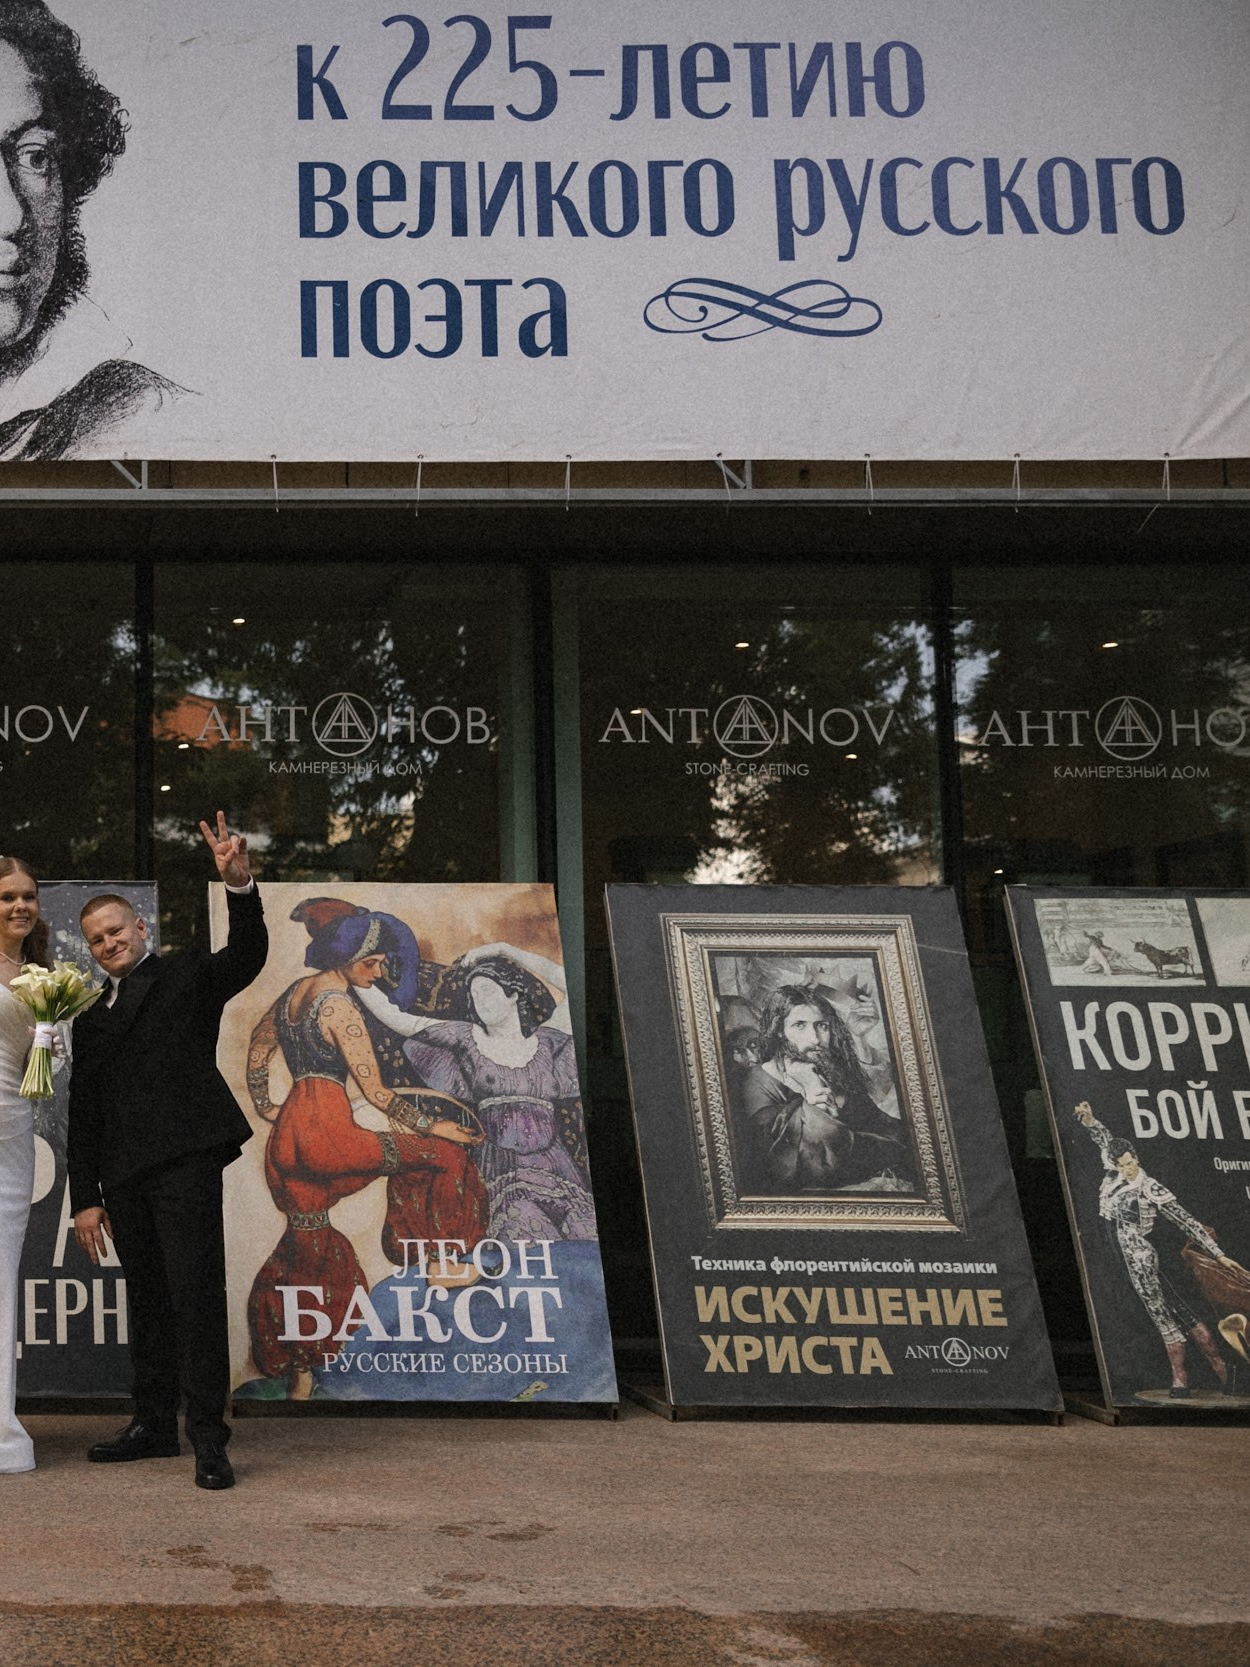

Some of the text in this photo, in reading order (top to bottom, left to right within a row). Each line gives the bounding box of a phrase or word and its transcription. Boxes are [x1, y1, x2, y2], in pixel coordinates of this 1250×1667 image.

[296, 14, 925, 122] к 225-летию
[298, 156, 1186, 261] великого русского
[299, 277, 569, 359] поэта
[979, 696, 1247, 760] АНТОНО
[269, 760, 380, 775] КАМНЕРЕЗНЫЙ
[685, 762, 810, 776] STONE-CRAFTING
[1053, 763, 1210, 780] КАМНЕРЕЗНЫЙ ДОМ
[1126, 1080, 1225, 1140] БОЙ
[1213, 1156, 1250, 1174] Ориги
[392, 1238, 559, 1281] ЛЕОН
[691, 1255, 998, 1276] Техника флорентийской мозаики
[16, 1278, 129, 1359] ЕРН
[275, 1285, 563, 1344] БАКСТ
[694, 1285, 1008, 1327] ИСКУШЕНИЕ
[322, 1353, 569, 1375] РУССКИЕ СЕЗОНЫ
[700, 1334, 894, 1375] ХРИСТА
